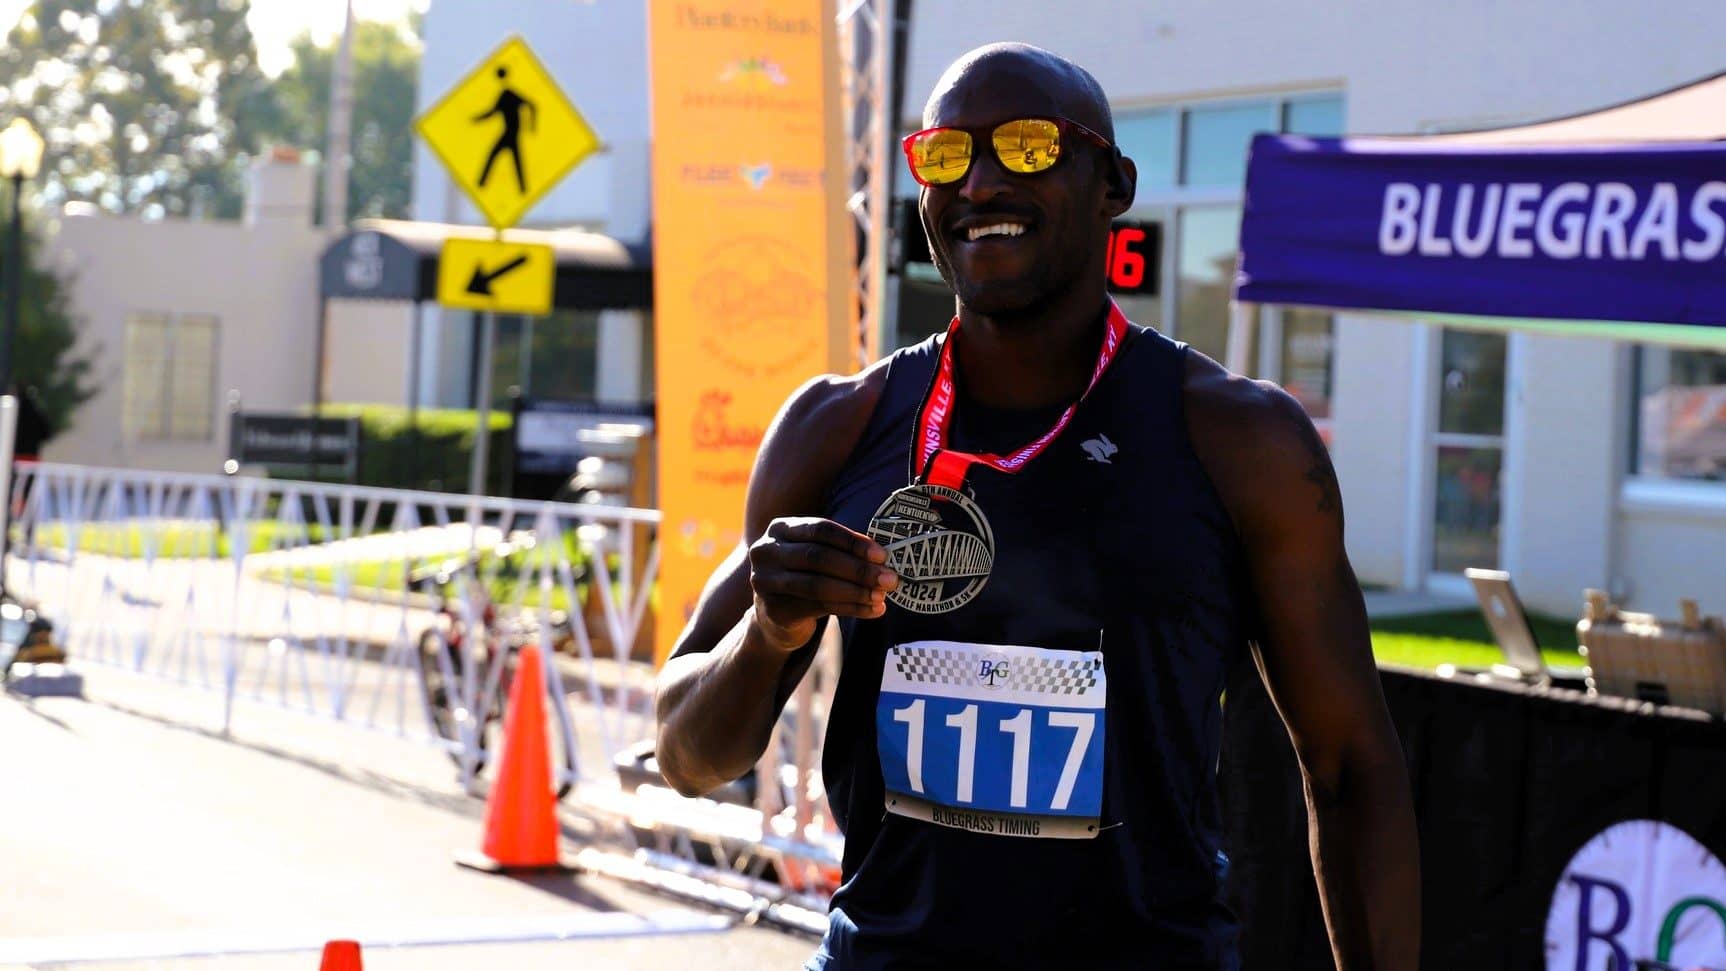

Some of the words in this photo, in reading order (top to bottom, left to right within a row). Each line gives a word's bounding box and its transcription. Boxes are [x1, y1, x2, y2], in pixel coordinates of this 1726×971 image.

[1379, 181, 1726, 262] BLUEGRAS
[1106, 228, 1146, 288] 6
[897, 595, 914, 608] HALF
[916, 600, 955, 613] MARATHON
[955, 597, 962, 606] &
[902, 581, 937, 601] 2024
[894, 698, 1096, 811] 1117
[932, 807, 995, 833] BLUEGRASS
[998, 818, 1040, 836] TIMING
